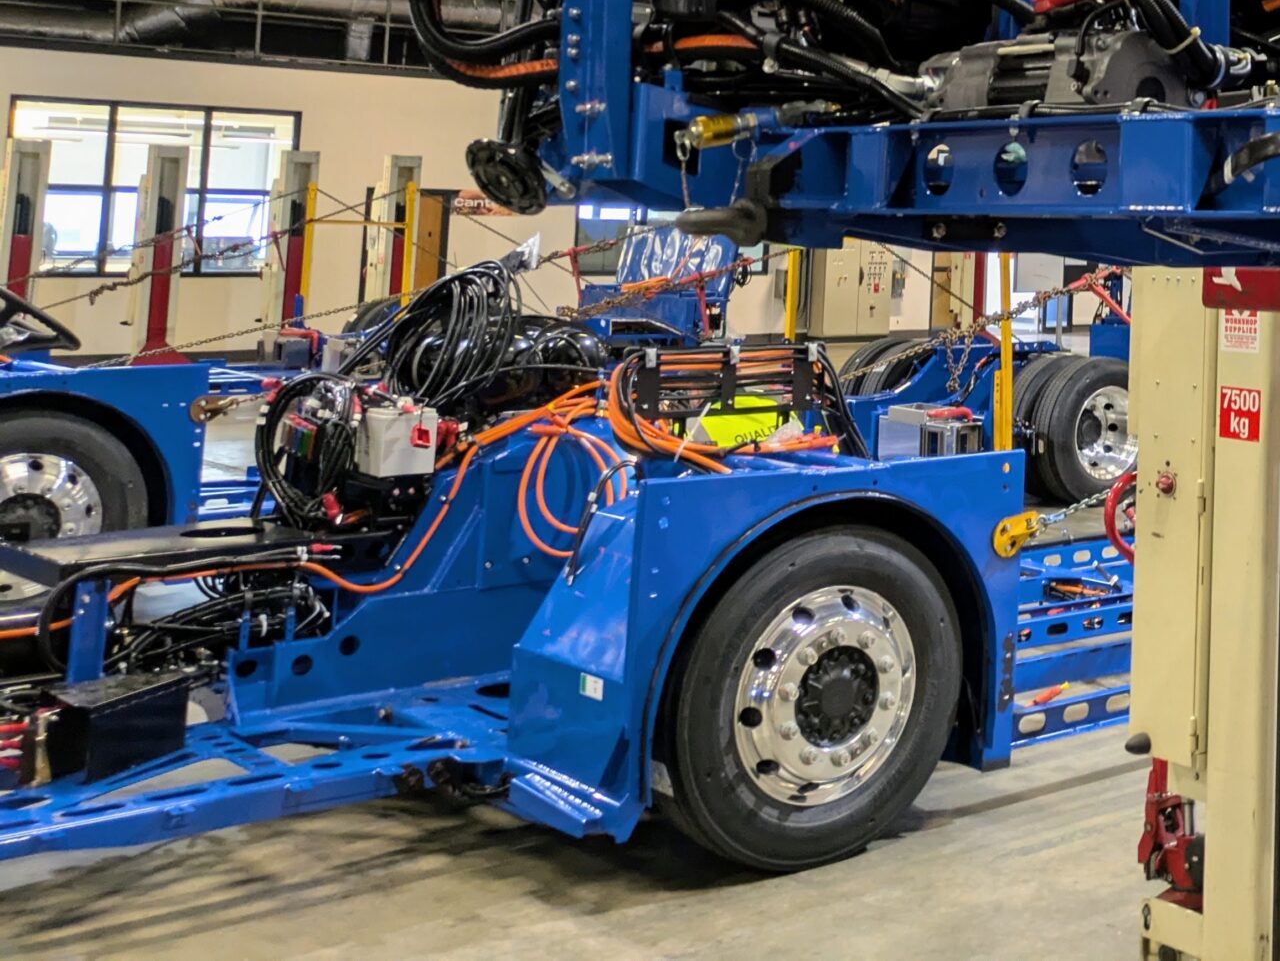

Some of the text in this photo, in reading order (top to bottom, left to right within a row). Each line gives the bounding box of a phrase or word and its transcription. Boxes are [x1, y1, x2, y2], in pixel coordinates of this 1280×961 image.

[1225, 317, 1258, 326] WORKSHOP
[1225, 325, 1258, 335] SUPPLIES
[1222, 388, 1260, 413] 7500
[1229, 415, 1250, 439] kg
